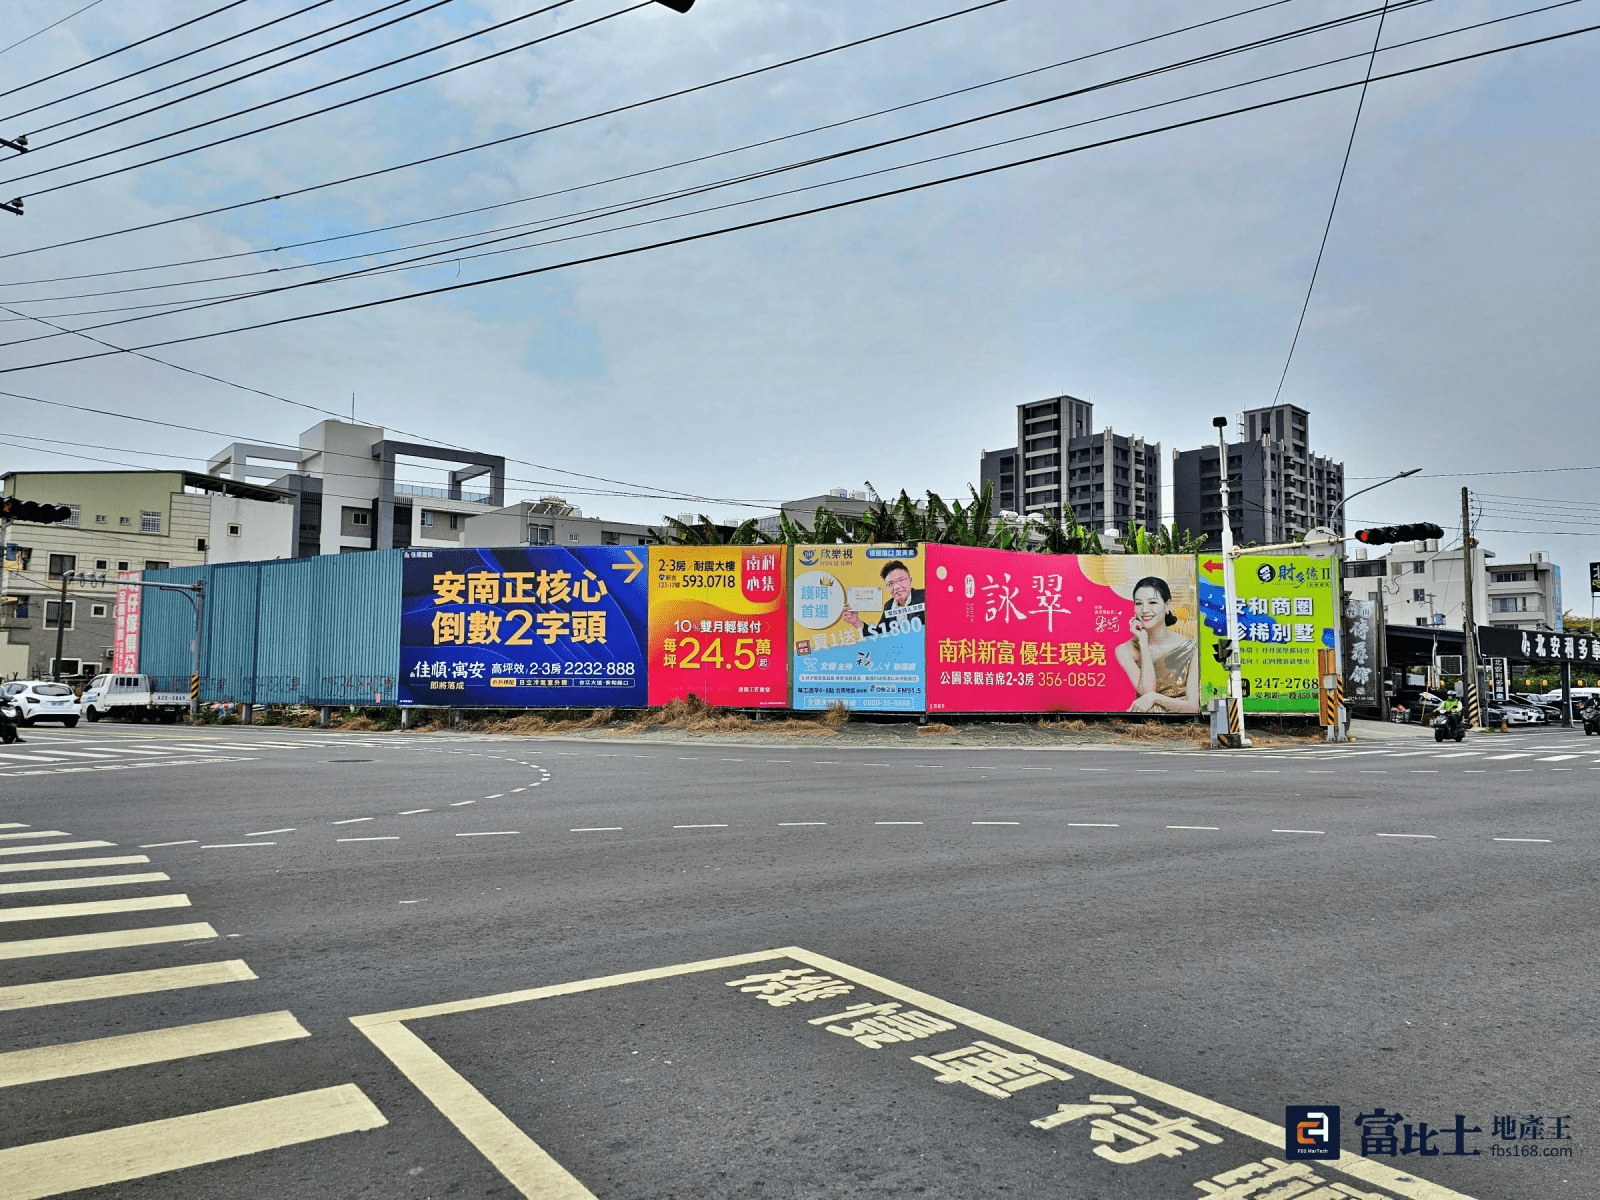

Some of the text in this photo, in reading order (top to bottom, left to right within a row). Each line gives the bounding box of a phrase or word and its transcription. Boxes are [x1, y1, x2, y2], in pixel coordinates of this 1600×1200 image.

[820, 548, 853, 559] 欣樂視
[746, 555, 775, 571] 南科
[432, 570, 608, 605] 安南正核心
[682, 575, 736, 588] 593.0718
[801, 586, 829, 600] 護眼
[801, 604, 829, 618] 首選
[981, 572, 1072, 633] 詠翠
[431, 609, 607, 646] 倒數2字頭
[868, 616, 921, 641] $1800
[663, 637, 677, 669] 每坪
[679, 637, 755, 670] 24.5
[938, 637, 1107, 667] 南科新富 優生環境
[564, 662, 635, 675] 2232-888
[940, 671, 1106, 688] 公園景觀首席2-3房 356-0852
[1255, 678, 1319, 689] 247-2768
